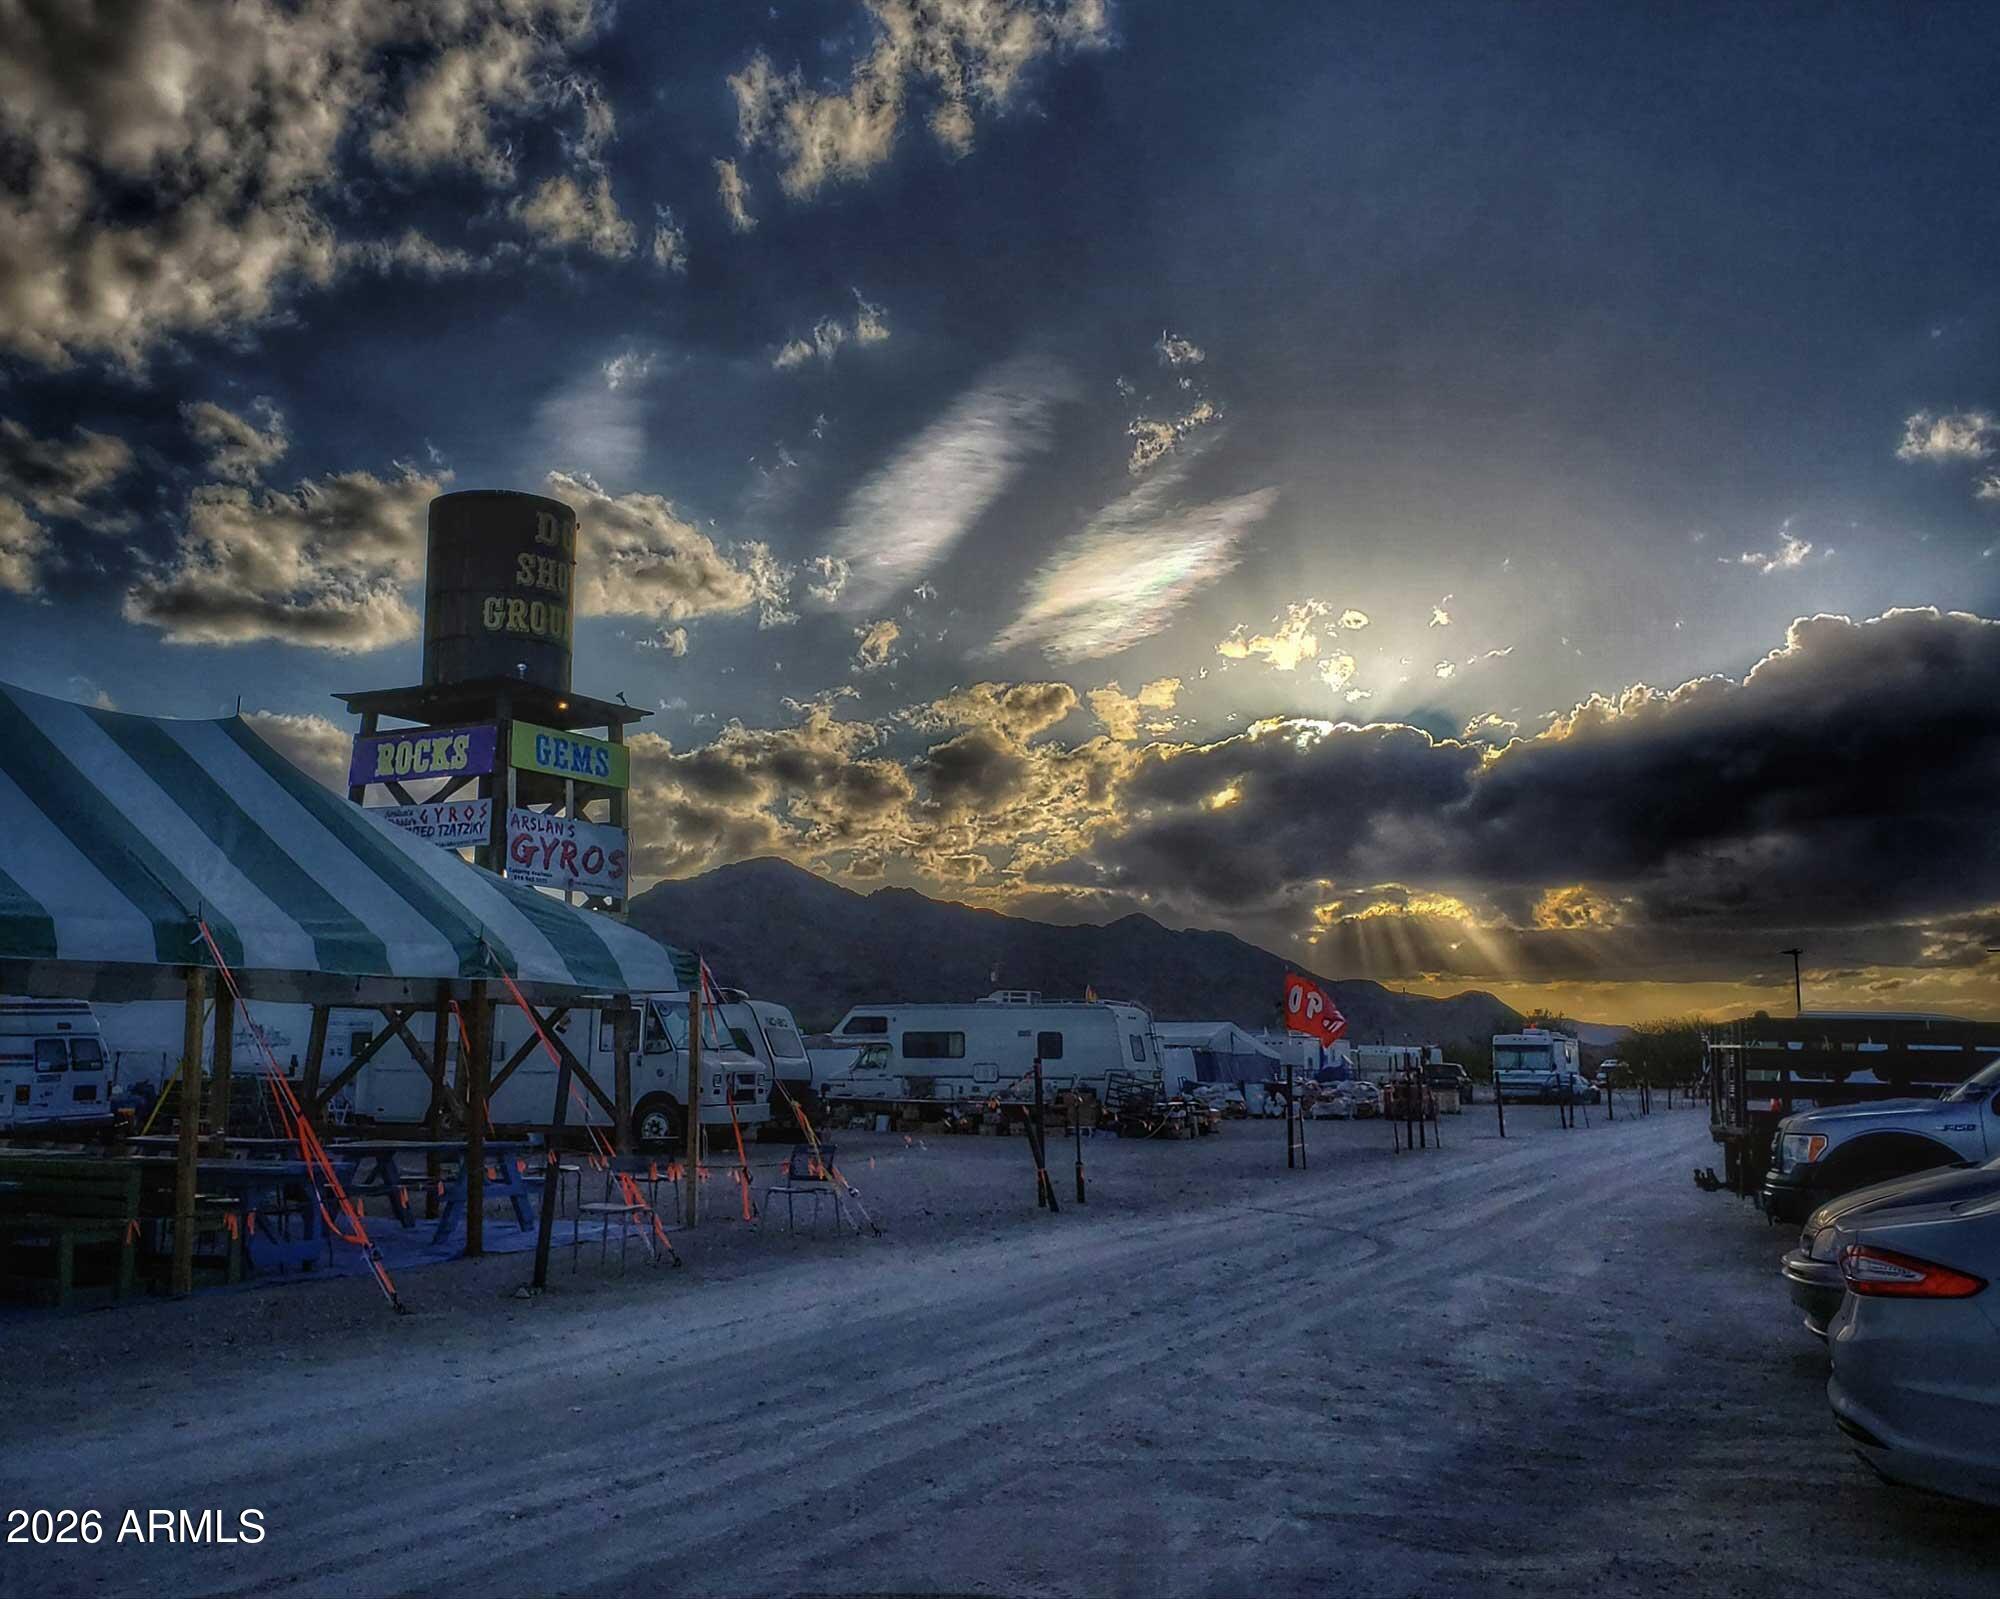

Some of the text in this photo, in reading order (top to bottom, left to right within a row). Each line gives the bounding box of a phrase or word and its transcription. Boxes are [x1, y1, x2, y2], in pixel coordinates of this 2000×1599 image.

[375, 733, 469, 777] ROCKS
[534, 733, 609, 778] GEMS
[420, 801, 488, 825] GYROS
[511, 833, 626, 880] GYROS
